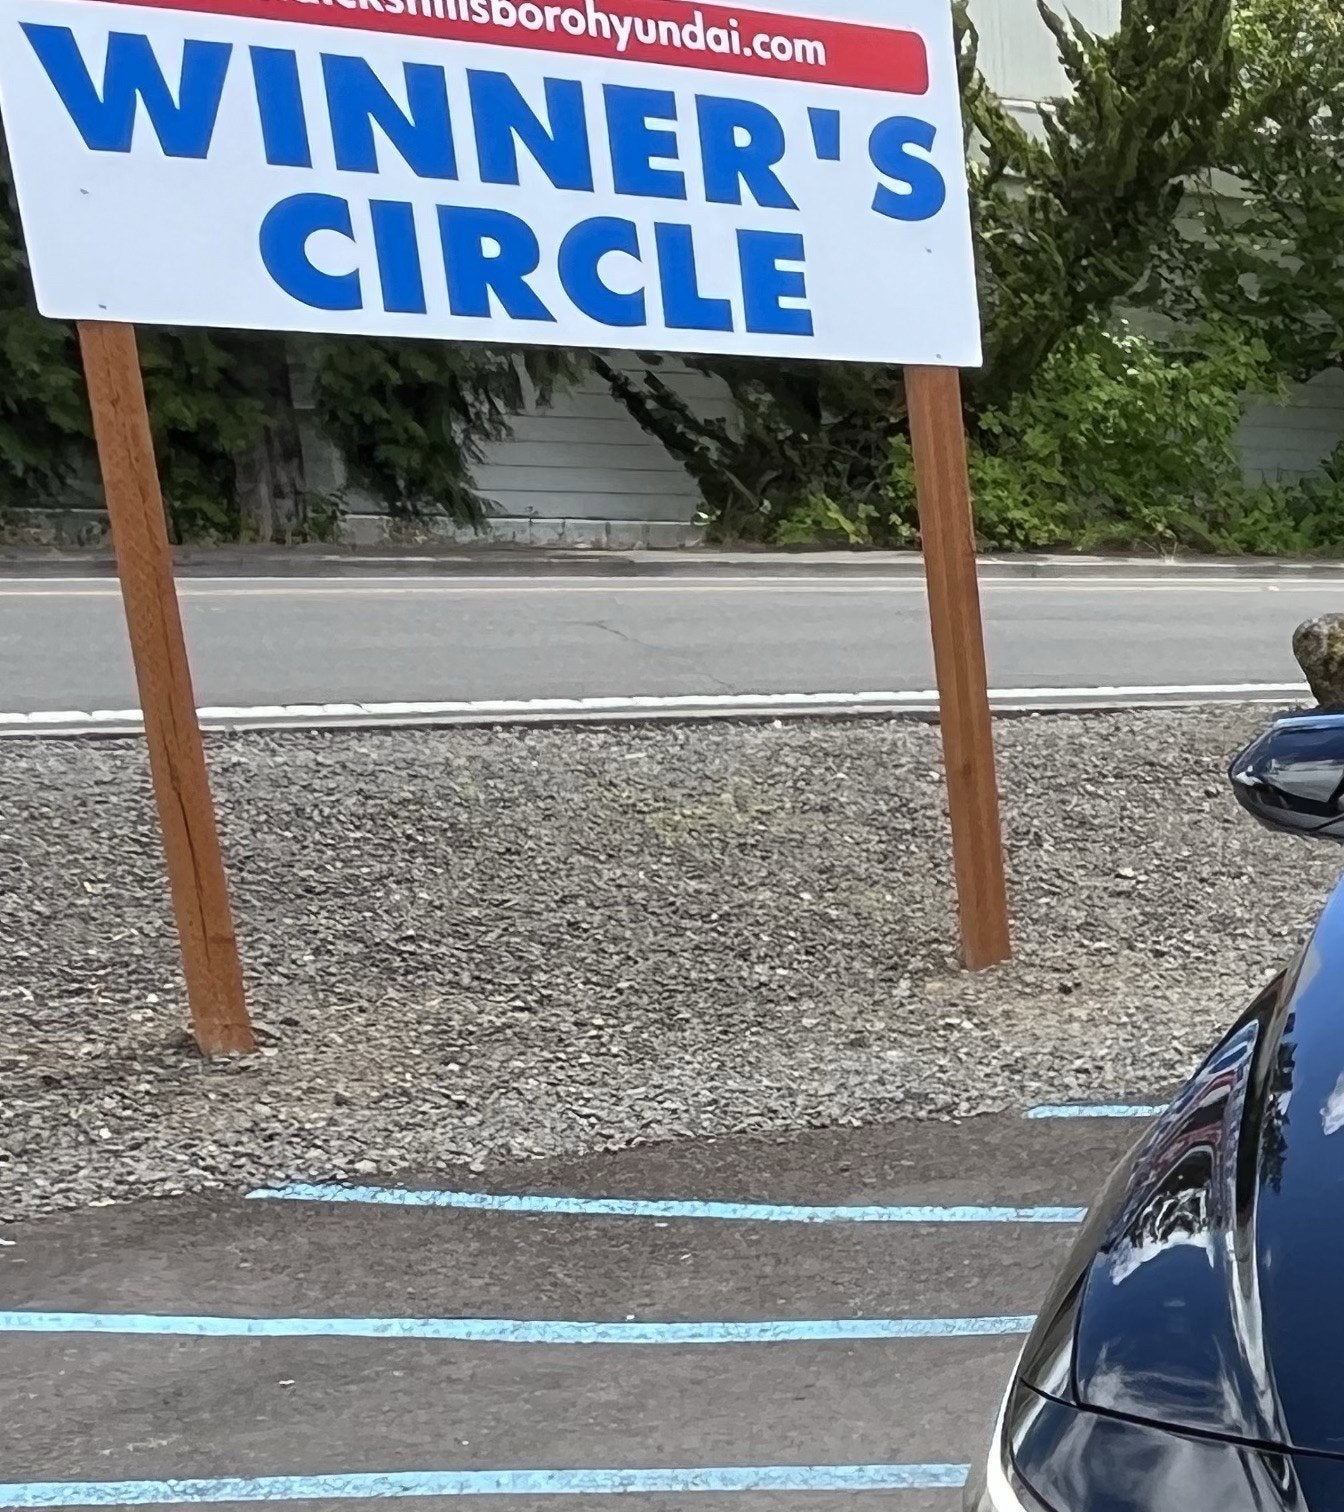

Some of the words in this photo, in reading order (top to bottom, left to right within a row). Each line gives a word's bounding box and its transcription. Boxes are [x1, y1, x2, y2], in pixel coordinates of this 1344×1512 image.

[297, 0, 827, 66] sillsborohyundai.com
[17, 22, 947, 222] WINNER'S
[259, 192, 815, 338] CIRCLE
